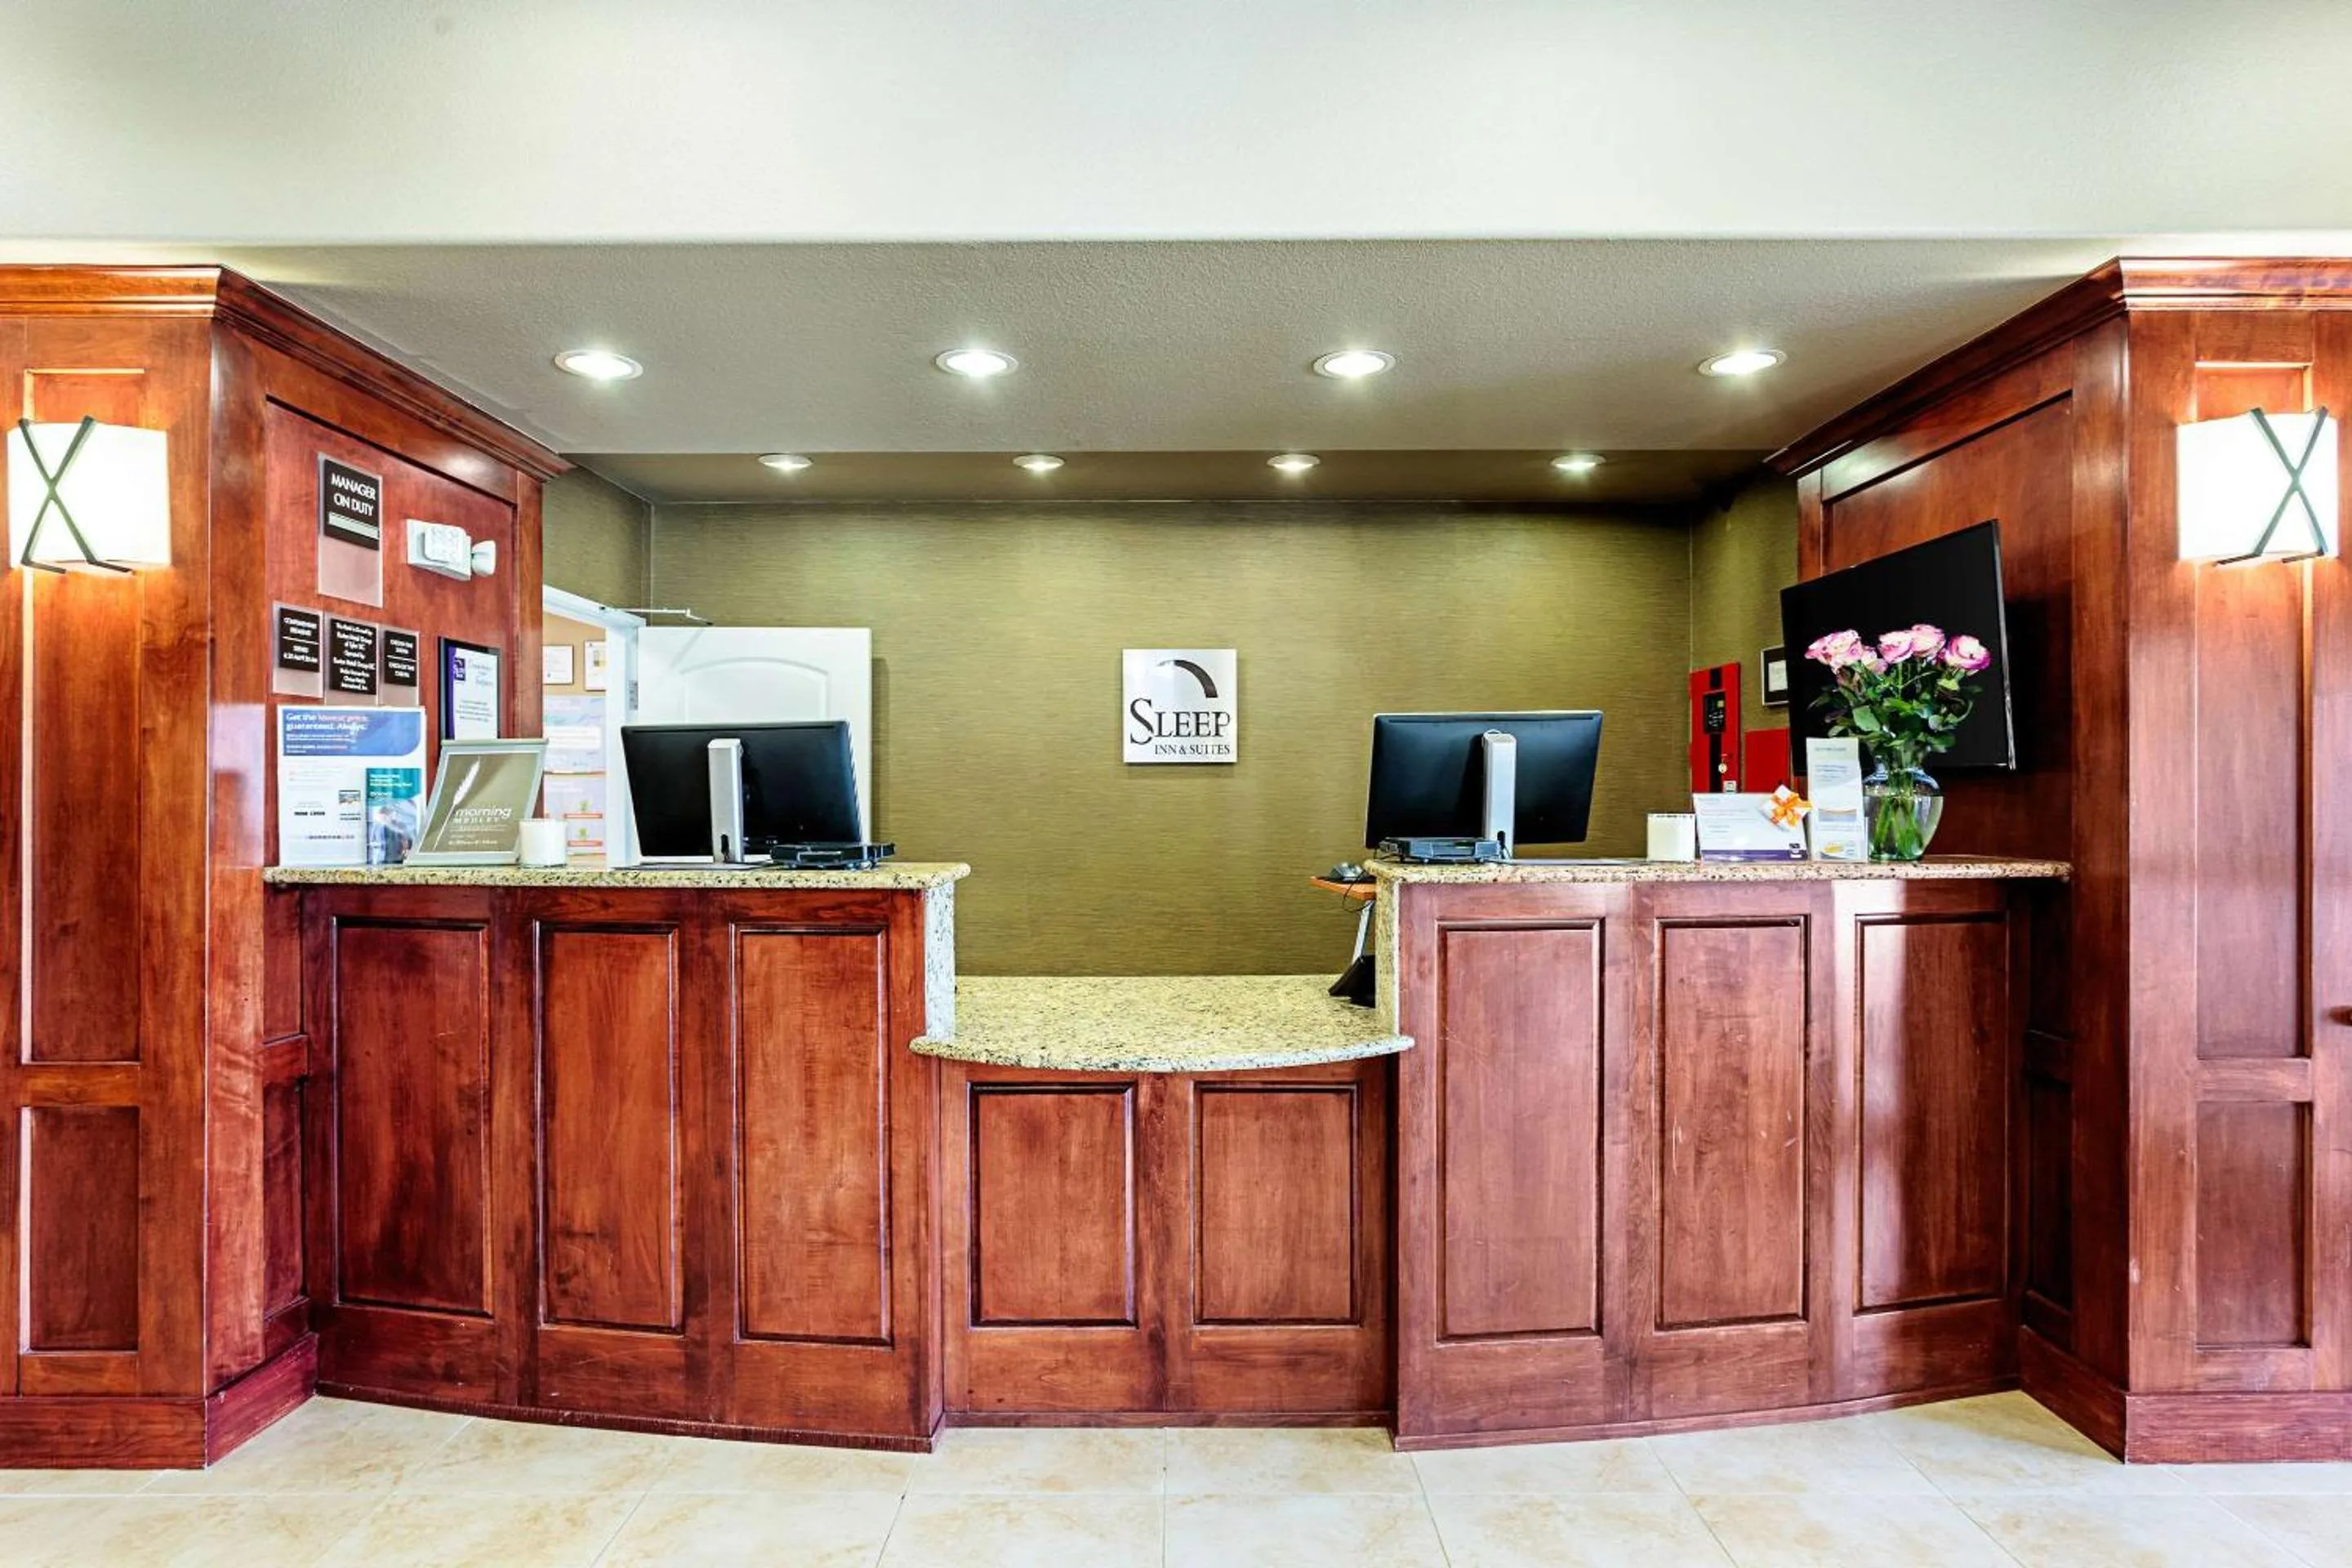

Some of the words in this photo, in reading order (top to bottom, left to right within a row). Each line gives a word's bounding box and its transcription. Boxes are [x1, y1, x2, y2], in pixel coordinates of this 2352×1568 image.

[331, 474, 376, 500] MANAGER
[333, 493, 350, 509] ON
[351, 499, 373, 516] DUTY
[1130, 697, 1231, 745] SLEEP
[1155, 745, 1176, 755] INN
[1178, 745, 1187, 755] &
[1189, 744, 1230, 755] SUITES
[456, 808, 512, 820] morning
